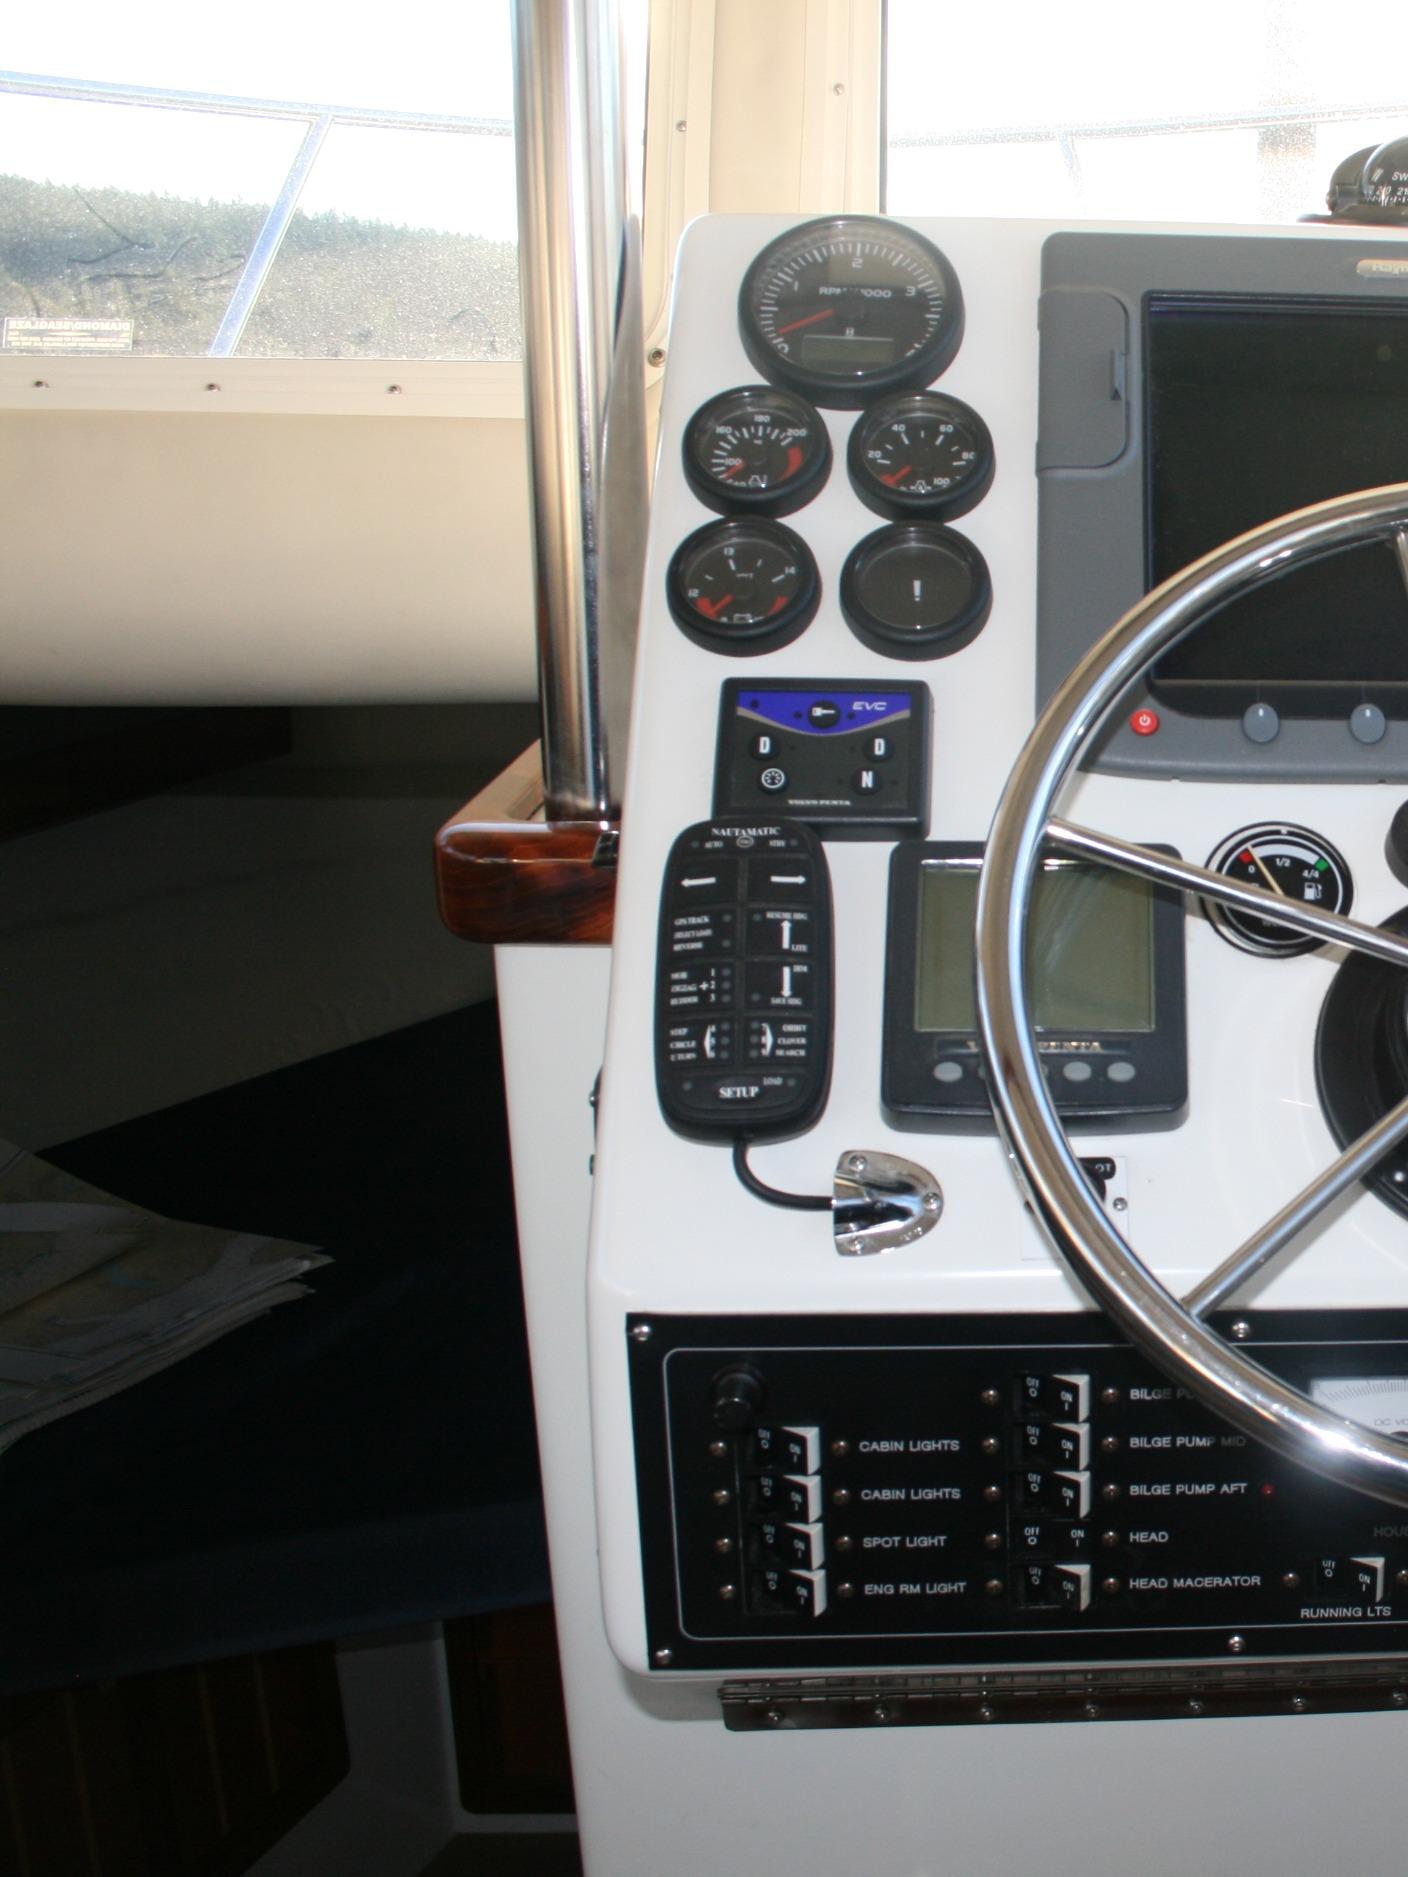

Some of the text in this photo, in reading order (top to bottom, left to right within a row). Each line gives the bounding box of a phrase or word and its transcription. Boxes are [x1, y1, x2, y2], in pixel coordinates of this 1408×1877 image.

[851, 258, 862, 268] 2
[905, 287, 916, 295] 3
[715, 426, 732, 434] 160
[787, 428, 806, 436] 200
[892, 424, 905, 432] 40
[868, 451, 881, 459] 20
[689, 589, 699, 597] 12
[852, 702, 887, 710] EVC
[760, 737, 770, 753] D
[874, 739, 884, 755] D
[862, 771, 872, 788] N
[712, 827, 781, 837] NAUTAMATIC
[1276, 858, 1290, 867] 1/2
[1303, 870, 1319, 878] 4/4
[719, 1087, 759, 1098] SETUP
[1026, 1377, 1040, 1388] OFF
[1061, 1390, 1072, 1402] ON
[1027, 1426, 1040, 1436] OFF
[859, 1440, 959, 1452] CABIN LIGHTS
[1062, 1439, 1072, 1450] ON
[1130, 1436, 1246, 1448] BILGE PUMP MID
[1028, 1473, 1040, 1484] OFF
[861, 1489, 960, 1500] CABIN LIGHTS
[1062, 1488, 1073, 1498] ON
[1130, 1484, 1247, 1495] BILGE PUMP AFT
[1024, 1527, 1040, 1536] OFF
[1071, 1530, 1084, 1538] ON
[863, 1536, 947, 1547] SPOT LIGHT
[1130, 1532, 1168, 1542] HEAD
[1130, 1576, 1260, 1589] HEAD MACERATOR
[1358, 1574, 1371, 1583] ON
[865, 1582, 966, 1595] ENG RM LIGHT
[1063, 1581, 1074, 1591] ON
[1301, 1606, 1391, 1619] RUNNING LTS
